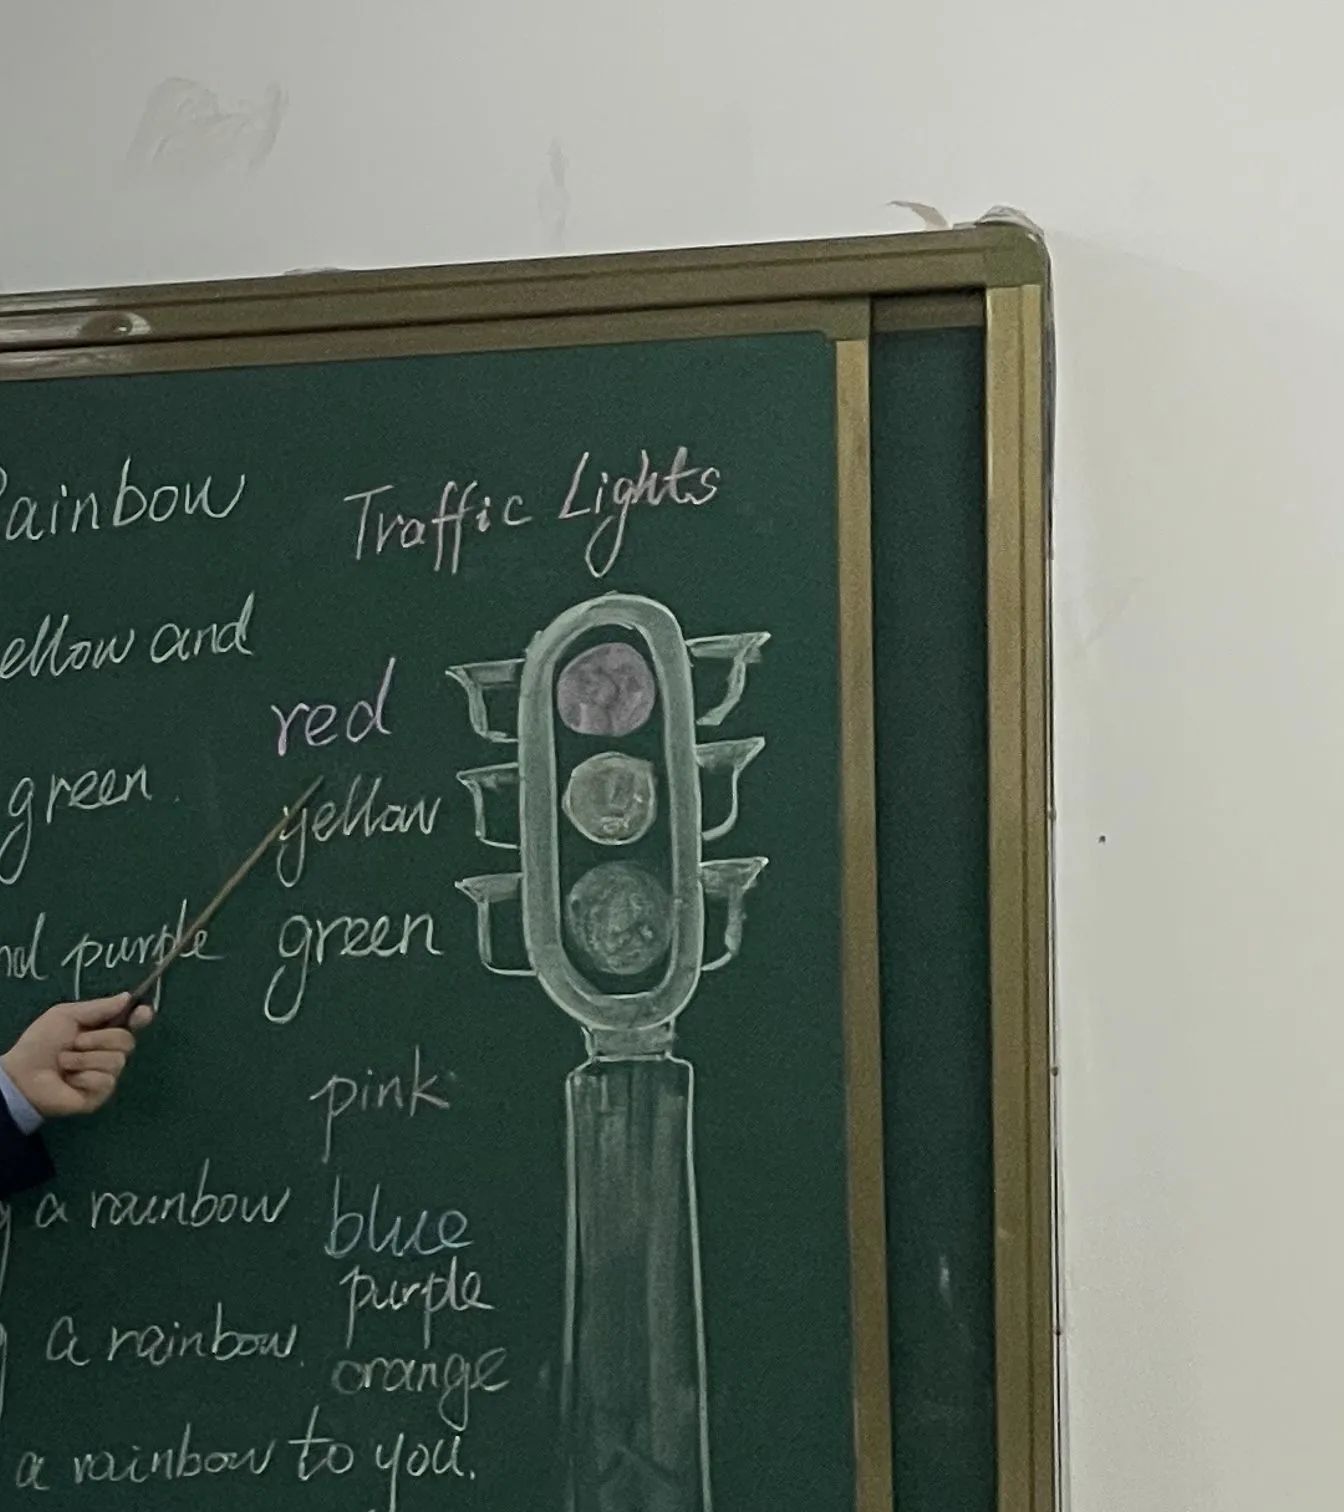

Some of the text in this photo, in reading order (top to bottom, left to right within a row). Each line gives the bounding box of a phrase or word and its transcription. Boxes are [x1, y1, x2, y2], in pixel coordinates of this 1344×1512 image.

[342, 447, 720, 578] Traffic Lights
[152, 591, 255, 664] and
[270, 658, 395, 755] red
[276, 775, 443, 887] yellow
[62, 899, 224, 1013] purple
[264, 913, 444, 1024] green
[310, 1047, 452, 1162] pink
[36, 1190, 70, 1227] a
[89, 1158, 291, 1229] rainbow
[325, 1178, 474, 1257] blue
[46, 1325, 87, 1362] a
[341, 1258, 495, 1347] purple
[332, 1343, 510, 1431] orange
[14, 1453, 49, 1491] a
[72, 1422, 278, 1483] rainbow
[287, 1405, 358, 1481] to
